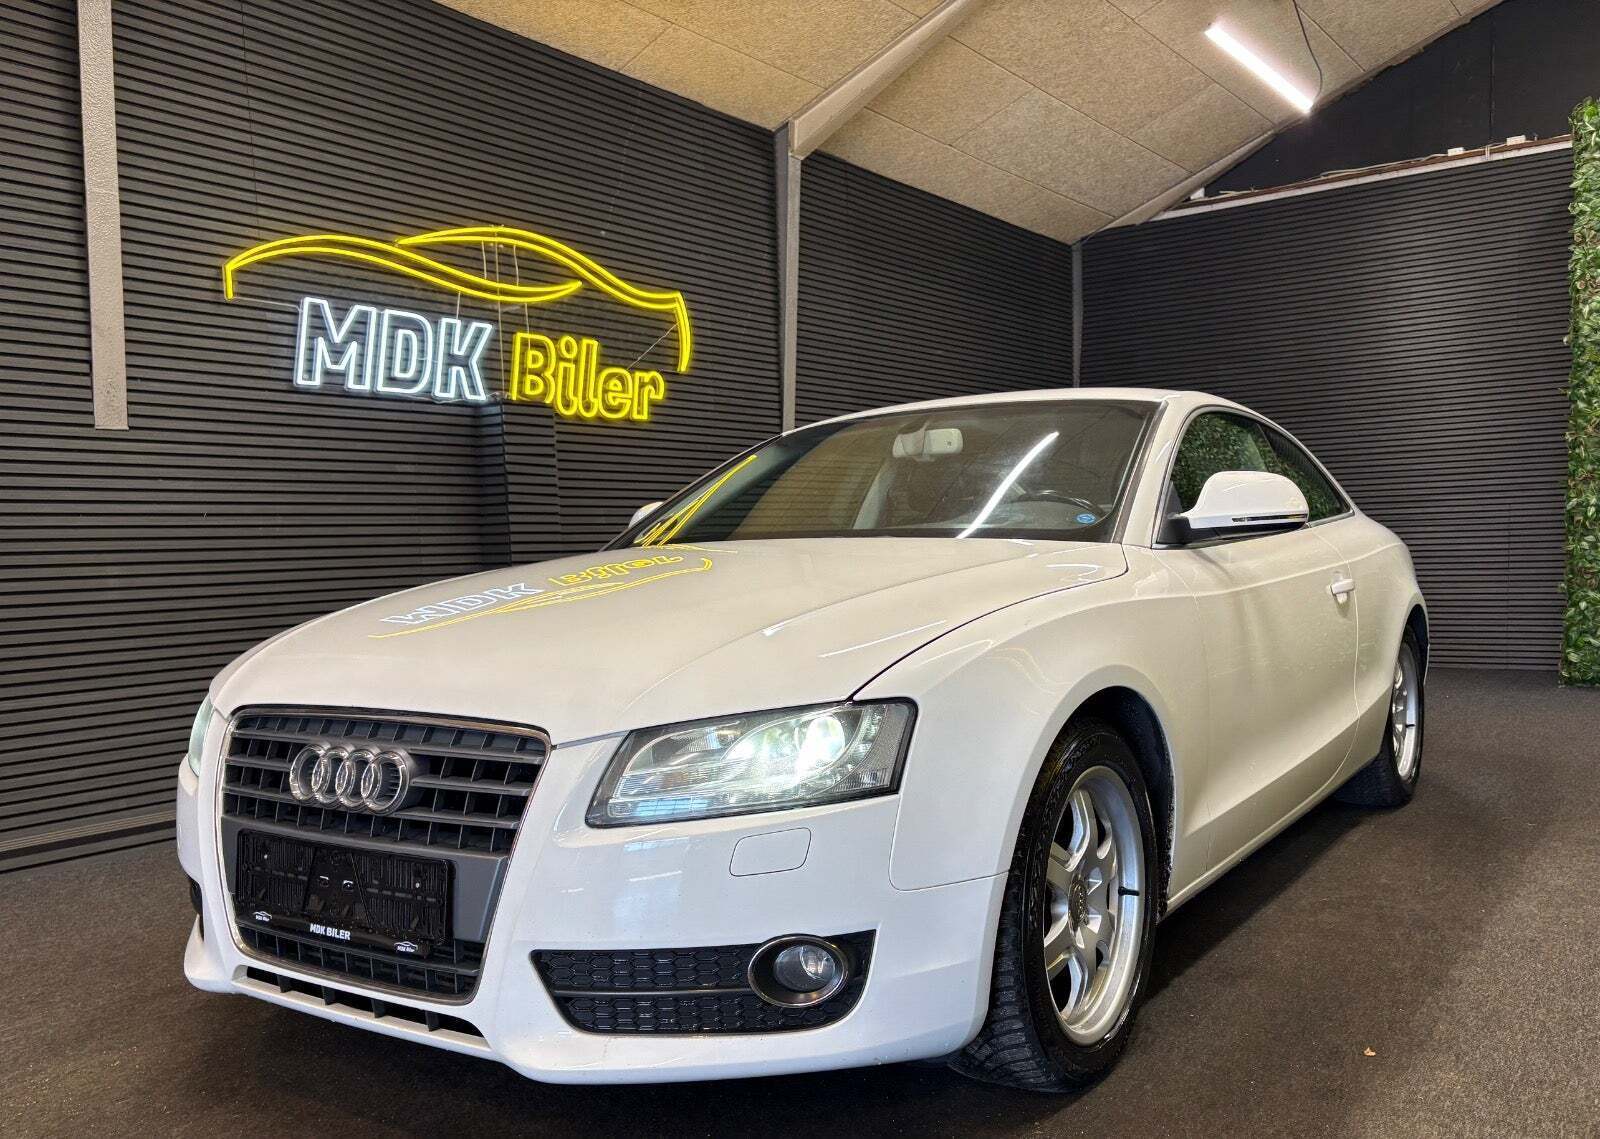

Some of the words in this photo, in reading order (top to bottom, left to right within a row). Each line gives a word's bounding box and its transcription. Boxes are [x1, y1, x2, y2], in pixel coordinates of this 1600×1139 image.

[294, 297, 493, 402] MDK
[510, 332, 665, 420] Biler
[310, 923, 325, 935] MDK
[326, 927, 351, 940] BILER
